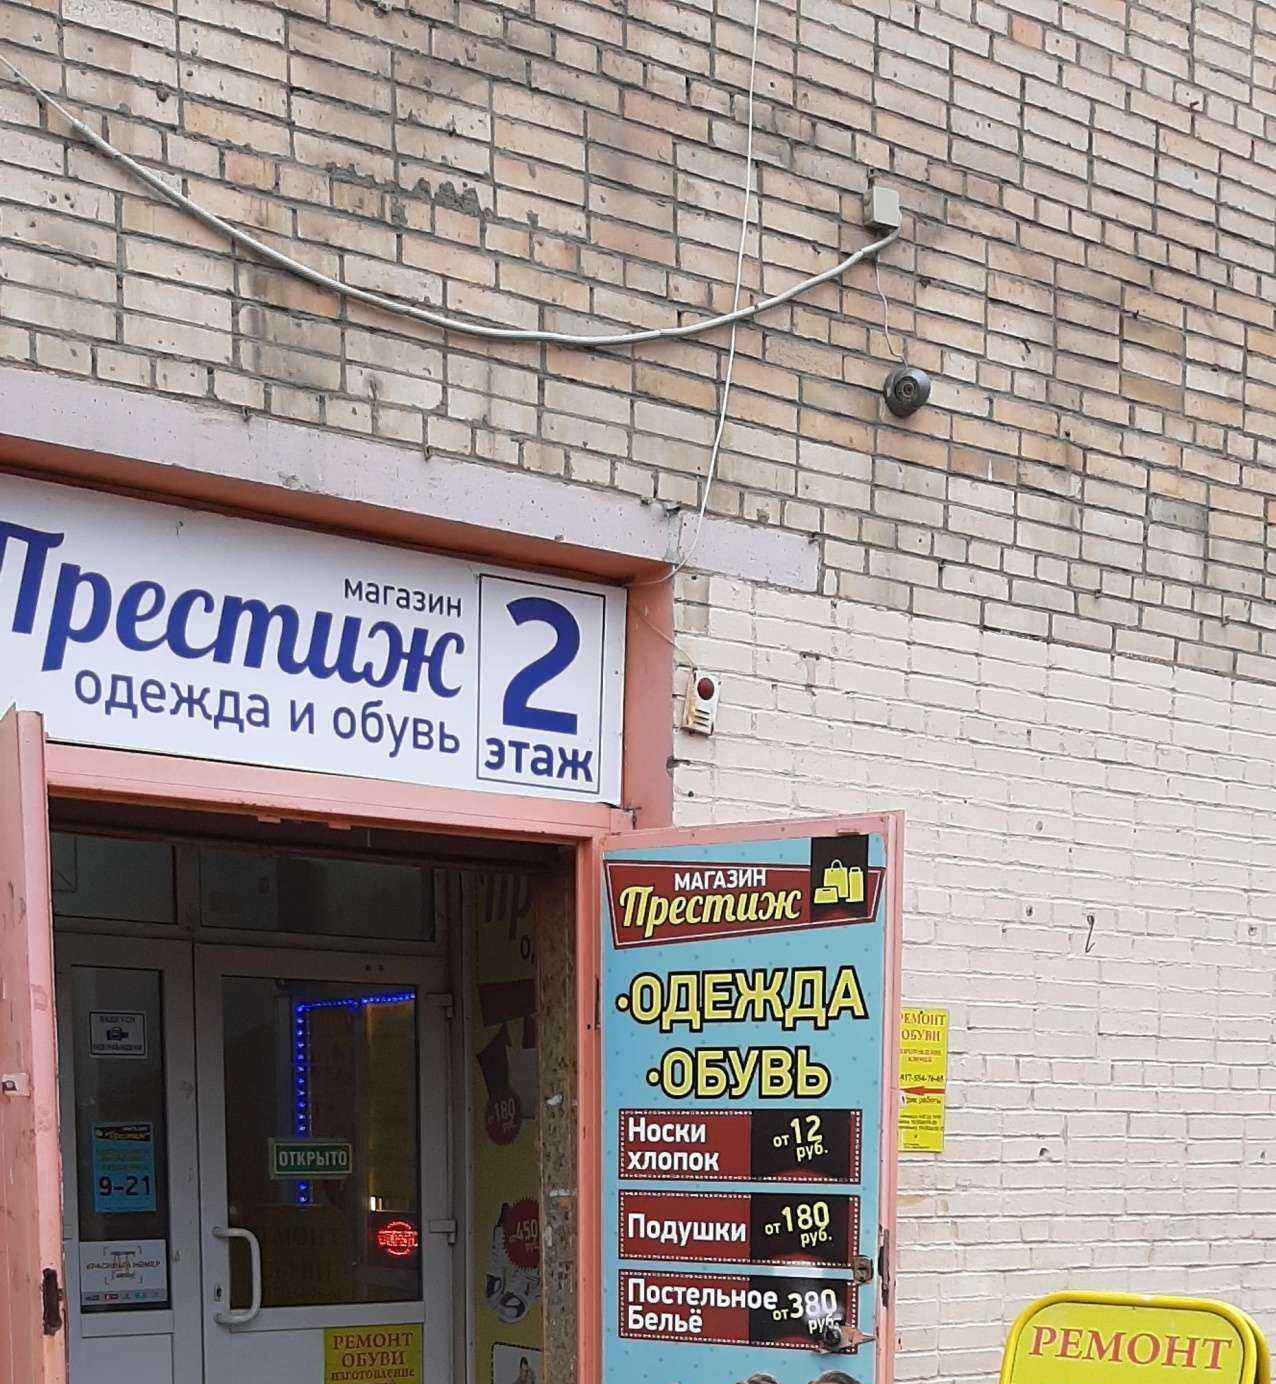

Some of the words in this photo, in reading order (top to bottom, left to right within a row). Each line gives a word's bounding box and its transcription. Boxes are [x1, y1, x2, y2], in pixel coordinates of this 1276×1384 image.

[0, 520, 466, 699] Престиж
[344, 577, 462, 618] магазин
[501, 597, 581, 736] 2
[74, 668, 270, 734] одежда
[289, 702, 315, 734] и
[333, 699, 461, 758] обувь
[484, 737, 594, 783] этаж
[674, 867, 767, 891] МАГАЗИН
[619, 885, 803, 938] Престиж
[627, 1116, 706, 1143] Носки
[773, 1134, 789, 1148] от
[790, 1115, 824, 1144] 12
[278, 1151, 348, 1167] ОТКРЫТО
[627, 1152, 720, 1172] хлопок
[796, 1142, 828, 1162] руб.
[99, 1175, 151, 1196] 9-21
[627, 1212, 747, 1247] Подушки
[764, 1222, 782, 1236] от
[781, 1201, 831, 1233] 180
[800, 1228, 833, 1248] руб.
[627, 1278, 778, 1310] Постельное
[772, 1309, 789, 1321] от
[787, 1288, 838, 1319] 380
[627, 1306, 703, 1333] Бельё
[333, 1332, 413, 1350] РЕМОНТ
[1028, 1324, 1233, 1371] РЕМОНТ
[341, 1350, 405, 1368] ОБУВИ
